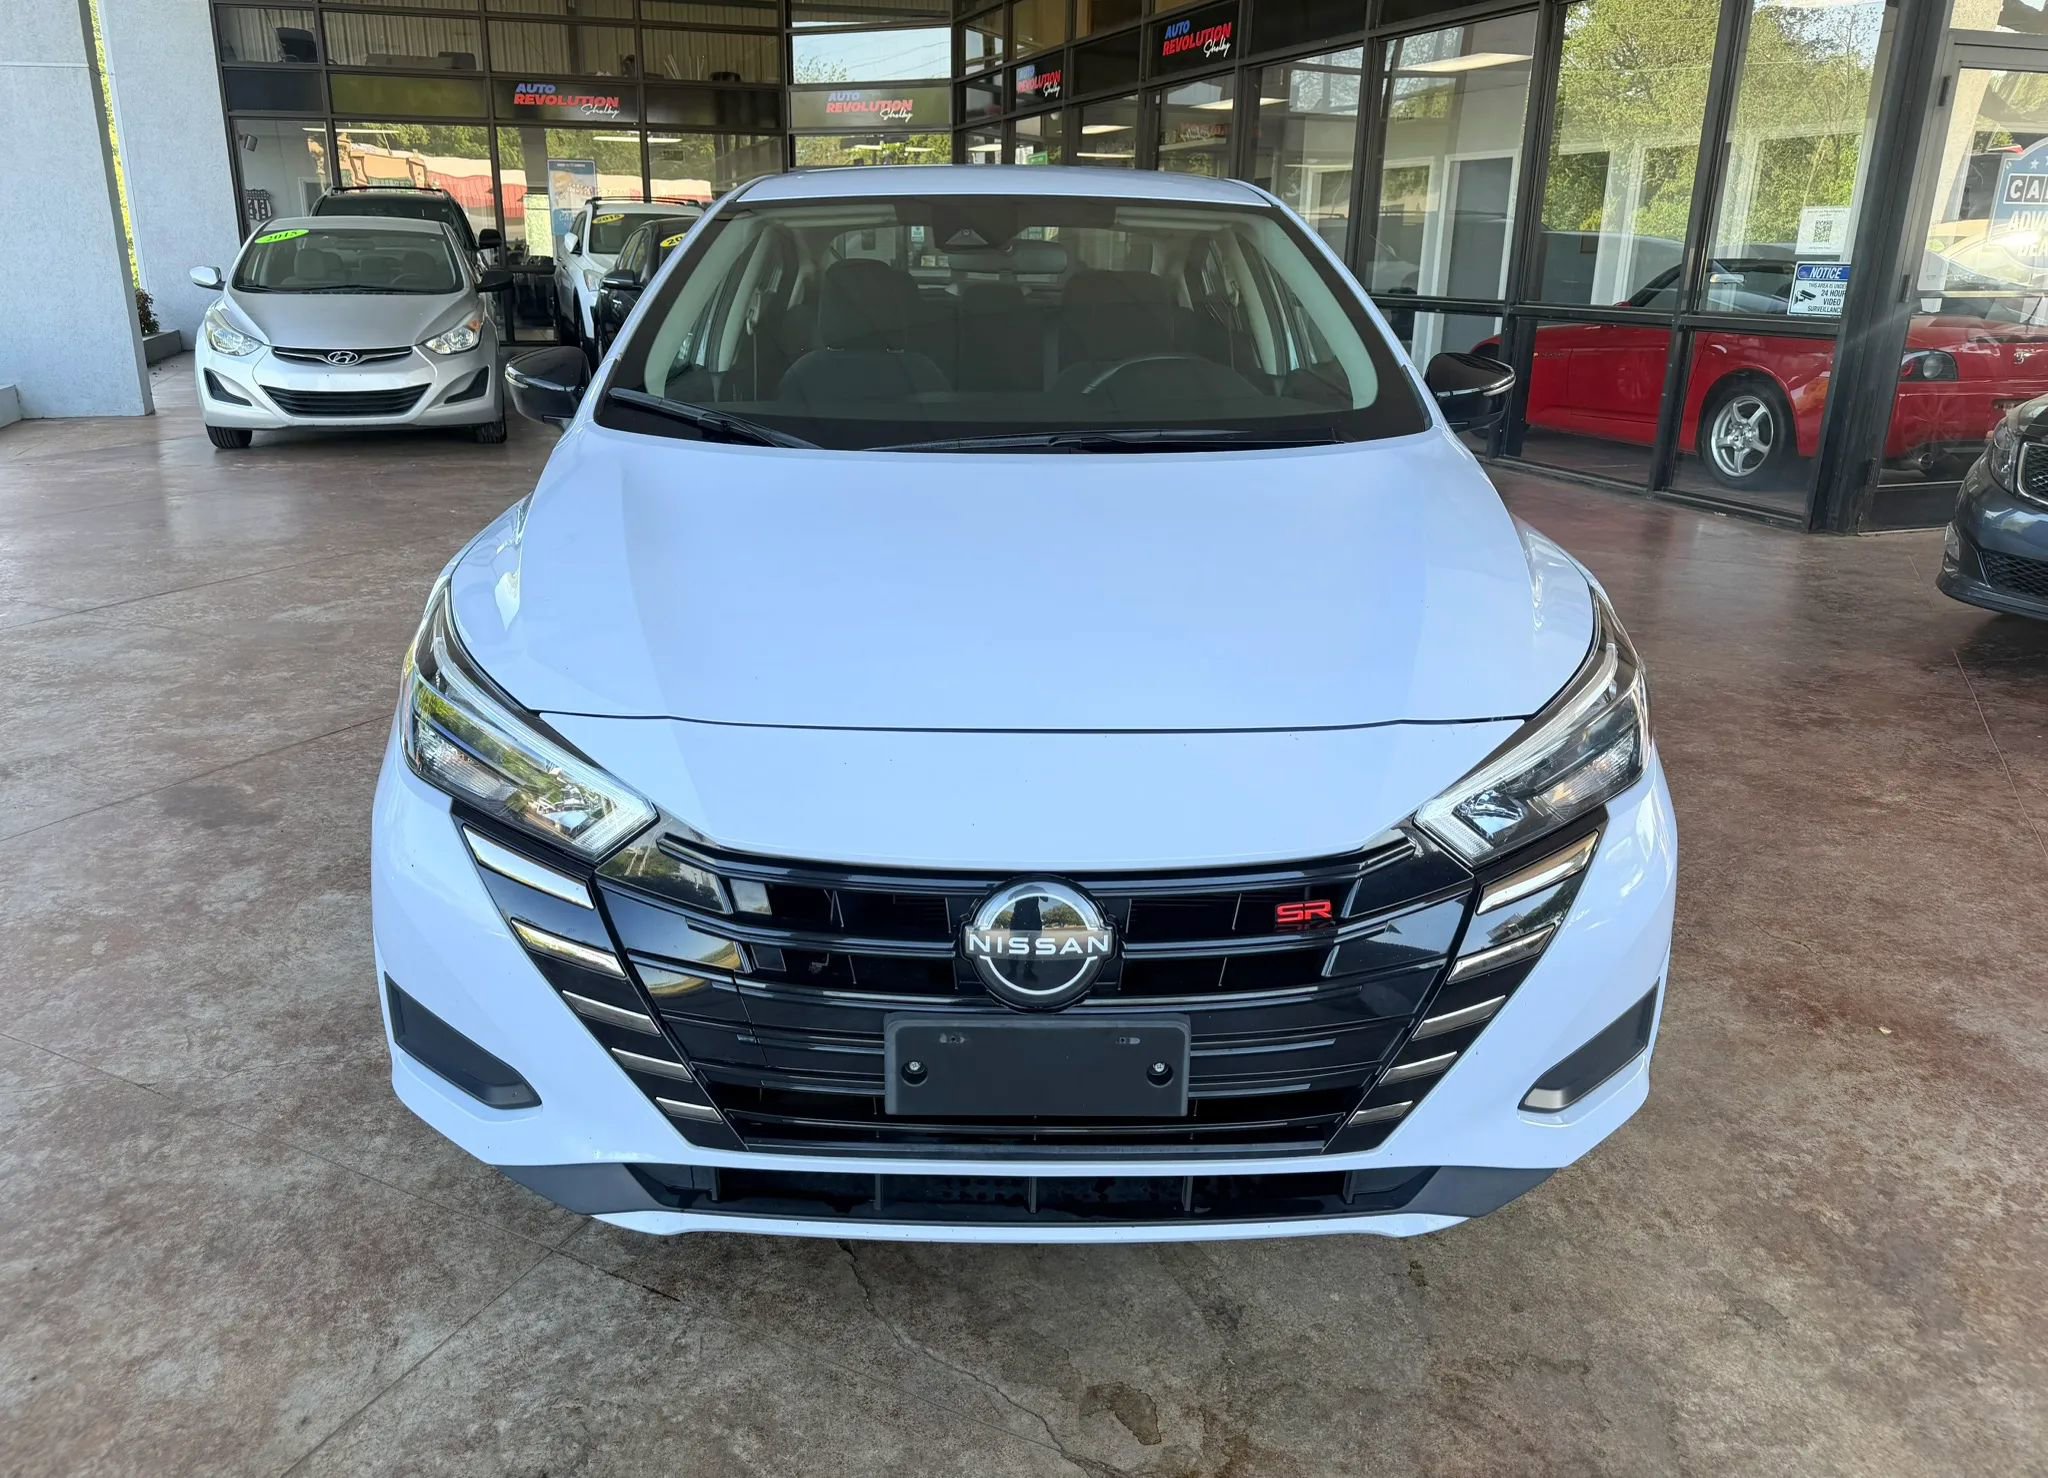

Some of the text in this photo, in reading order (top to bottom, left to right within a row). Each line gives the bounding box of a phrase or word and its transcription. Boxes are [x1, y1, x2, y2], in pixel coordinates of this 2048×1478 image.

[1165, 20, 1190, 39] AUTO
[1162, 22, 1232, 56] REVOLUTION
[1203, 35, 1231, 58] Shelby
[516, 83, 556, 94] AUTO
[514, 94, 619, 108] REVOLUTION
[828, 91, 860, 102] AUTO
[581, 103, 619, 118] Shelby
[826, 99, 913, 113] REVOLUTION
[880, 107, 913, 123] Shelby
[2010, 179, 2048, 199] CA
[1810, 266, 1842, 279] NOTICE
[1821, 289, 1828, 297] 24
[1823, 298, 1841, 306] VIDEO
[1276, 900, 1332, 923] SR
[968, 934, 1109, 956] NISSAN
